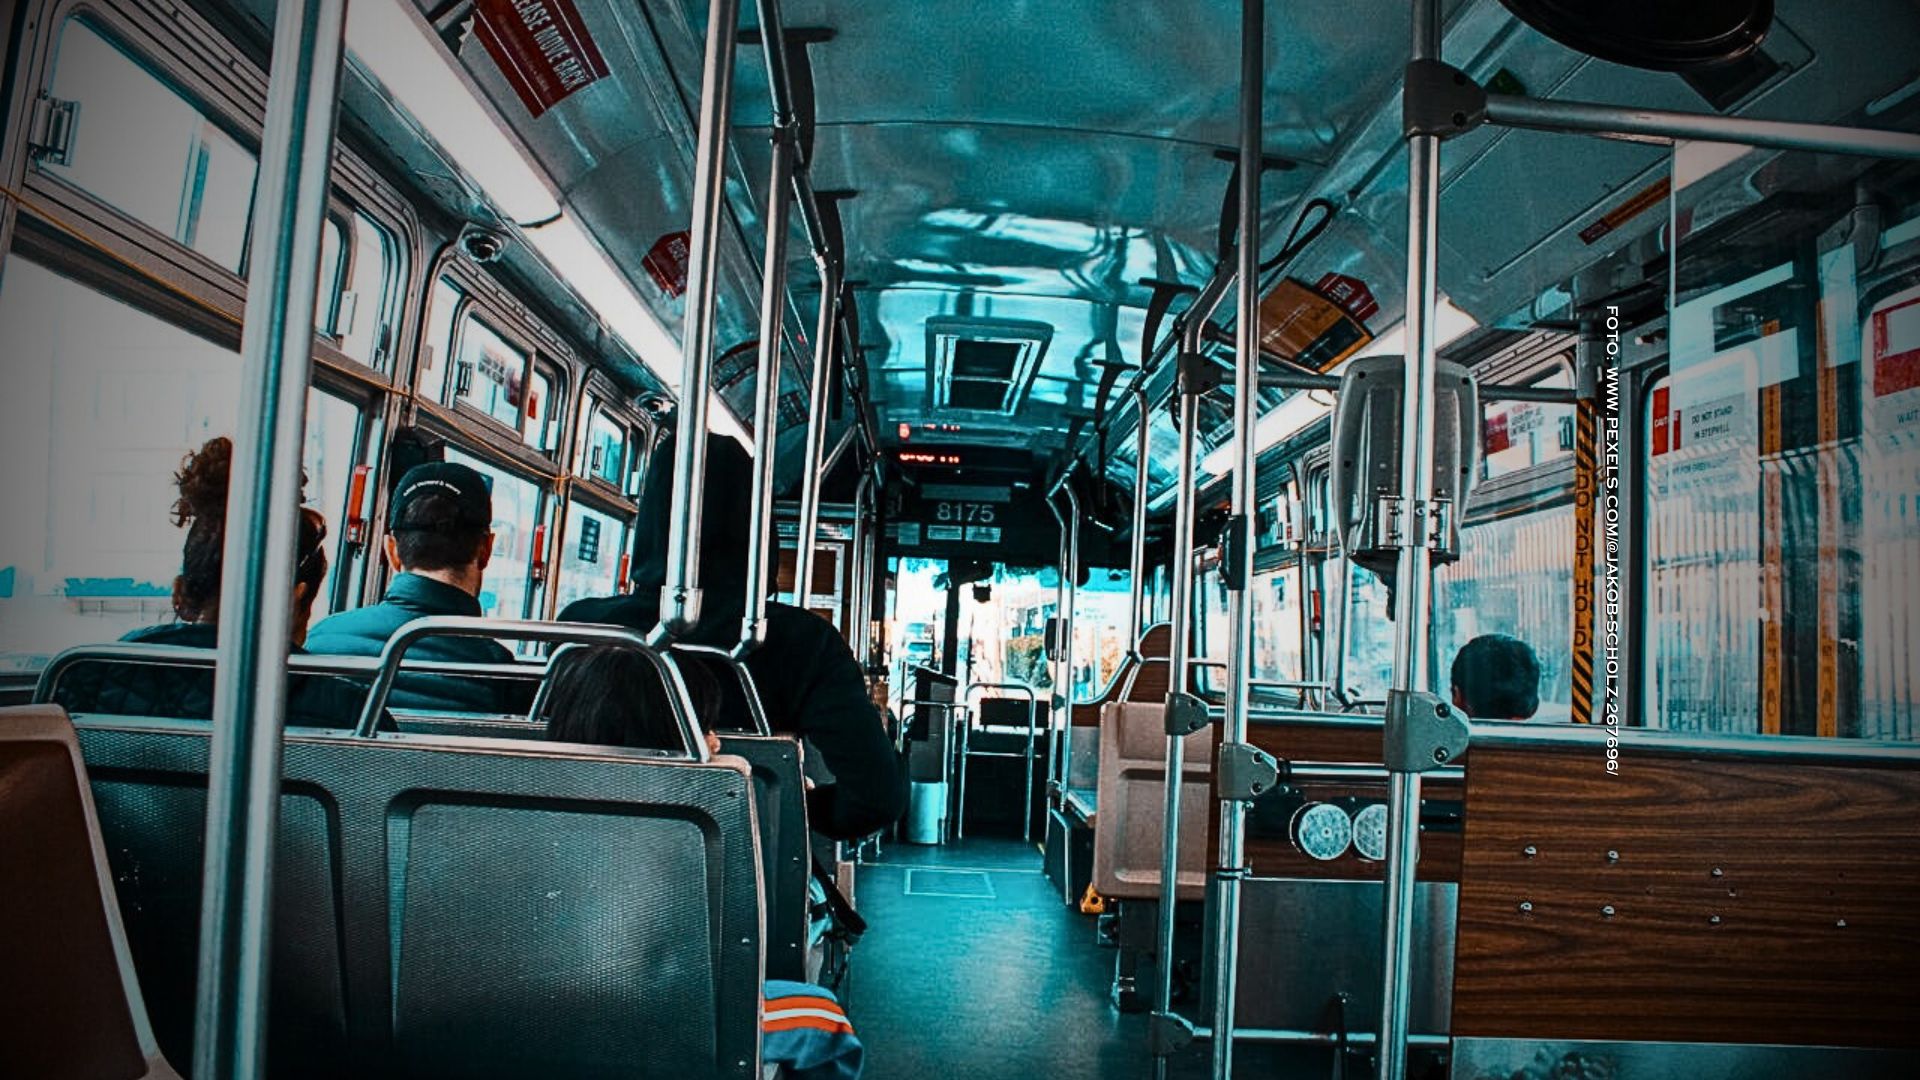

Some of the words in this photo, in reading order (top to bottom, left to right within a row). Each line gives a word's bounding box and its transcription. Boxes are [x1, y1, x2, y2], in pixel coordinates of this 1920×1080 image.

[511, 0, 552, 31] EASE
[533, 24, 571, 63] MOVE
[552, 56, 588, 91] BACK
[937, 502, 995, 523] 8175
[1575, 473, 1590, 508] DO
[1575, 517, 1590, 568] NOT
[1573, 583, 1589, 648] HOLD
